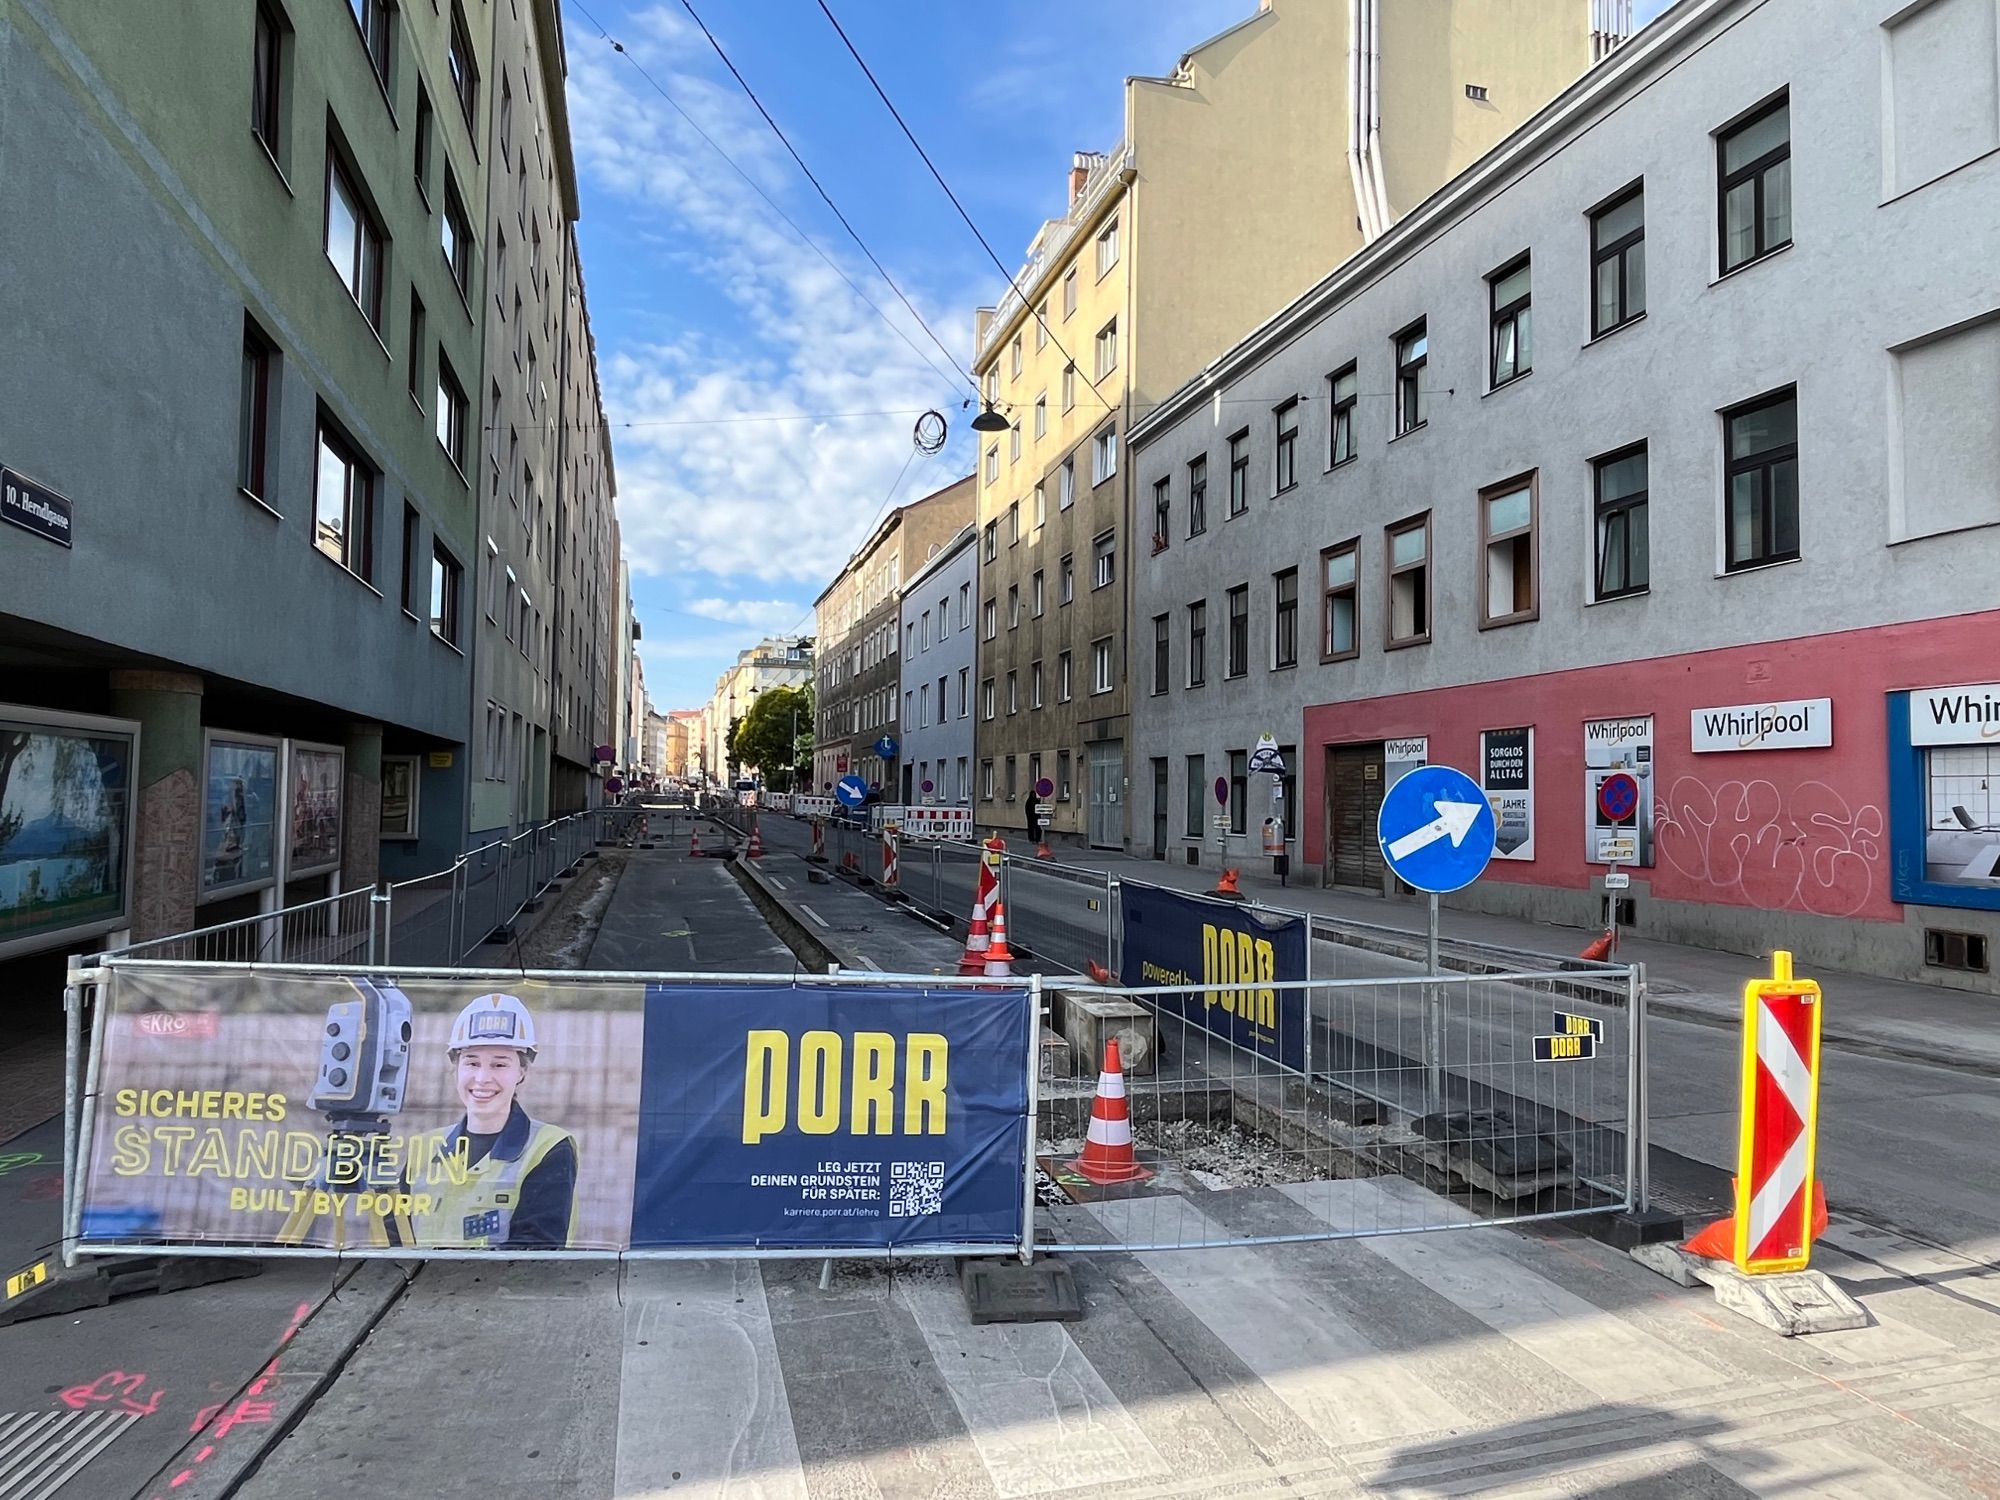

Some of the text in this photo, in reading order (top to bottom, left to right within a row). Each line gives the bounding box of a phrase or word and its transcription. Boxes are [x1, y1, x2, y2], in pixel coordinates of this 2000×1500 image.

[1586, 720, 1648, 742] Whirlpool
[1704, 706, 1809, 741] Whirlpool
[1386, 739, 1425, 757] Whirlpool
[1490, 746, 1523, 758] SORGLOS
[1490, 758, 1524, 769] DURCH DEN
[1490, 768, 1523, 779] ALLTAG
[1503, 799, 1526, 809] JAHRE
[1142, 960, 1182, 987] powered
[1203, 923, 1276, 1030] PORR
[1550, 1037, 1581, 1059] PORR
[742, 1029, 949, 1145] PORR
[115, 1088, 288, 1122] SICHERES
[111, 1124, 470, 1186] STANDBEIN
[817, 1161, 882, 1173] LEG JETZT
[751, 1174, 881, 1188] DEINEN GRUNDSTEIN
[230, 1187, 432, 1217] BUILT BY PORR
[802, 1186, 881, 1200] FÜR SPÄTER:
[783, 1207, 881, 1219] karriere.porr.at/lehre
